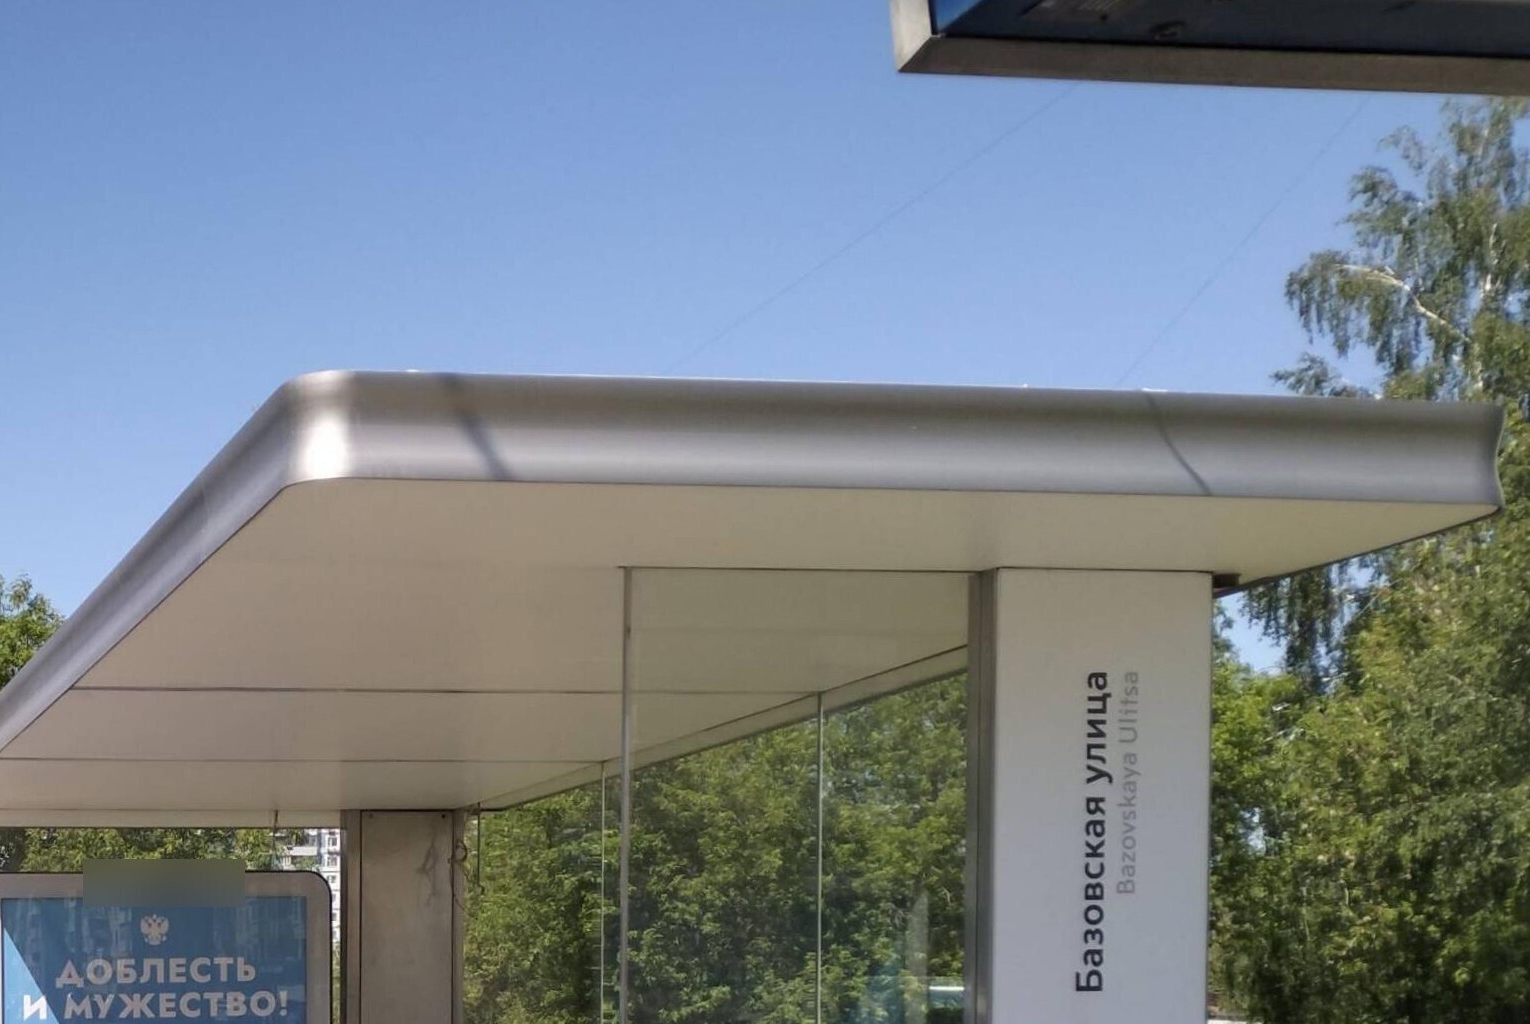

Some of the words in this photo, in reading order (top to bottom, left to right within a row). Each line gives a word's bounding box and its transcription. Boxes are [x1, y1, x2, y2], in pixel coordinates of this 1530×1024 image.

[1086, 671, 1113, 785] улица
[1117, 671, 1139, 744] Ulitsa
[1116, 752, 1141, 896] Bazovskaya
[1074, 796, 1106, 993] Базовская
[22, 994, 49, 1021] И
[63, 990, 288, 1020] МУЖЕСТВО!
[55, 956, 257, 989] ДОБЛЕСТЬ
